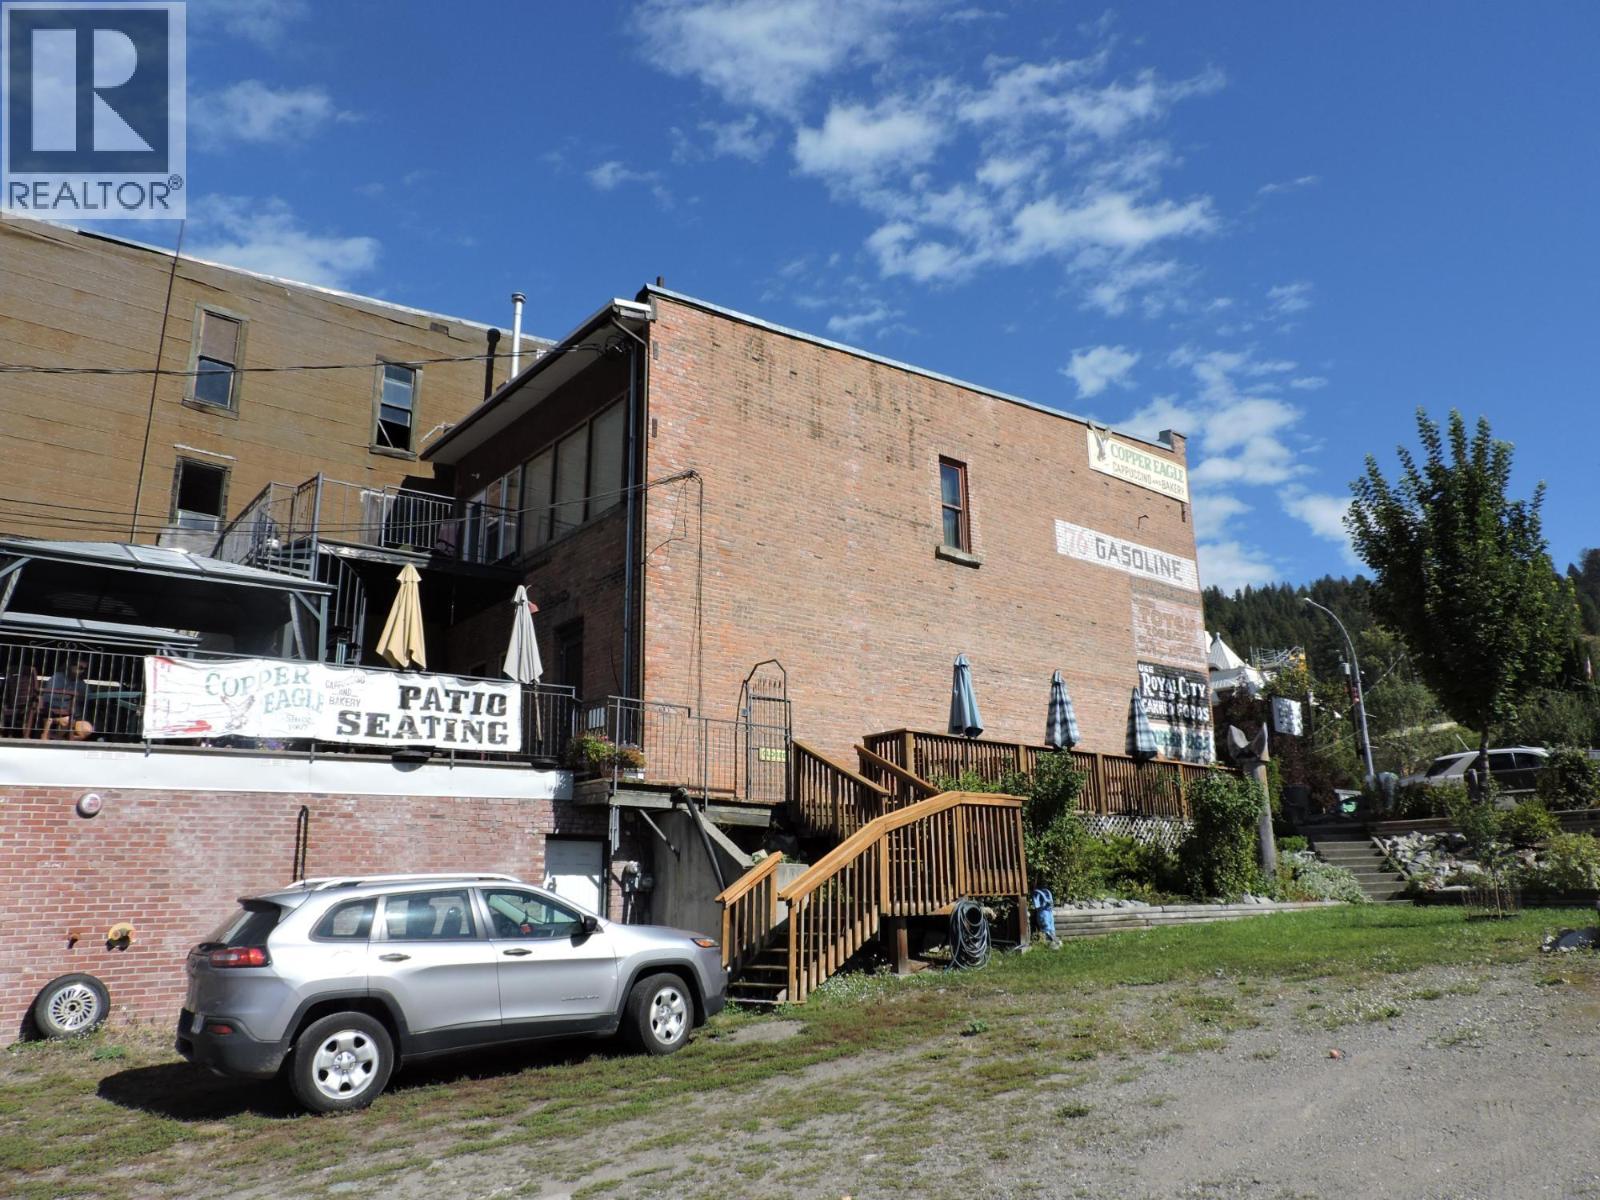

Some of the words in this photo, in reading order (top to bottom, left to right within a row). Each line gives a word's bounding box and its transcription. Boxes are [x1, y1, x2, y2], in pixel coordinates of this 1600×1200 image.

[1110, 443, 1152, 472] COPPER
[1153, 459, 1185, 484] EAGLE
[1112, 461, 1152, 485] CAPPUCCINO
[1161, 479, 1185, 495] BAKERY
[1095, 536, 1183, 581] GASOLINE
[205, 665, 312, 698] COPPER
[1138, 663, 1154, 674] USE
[1140, 672, 1178, 697] ROYAL
[329, 695, 361, 707] BAKERY
[398, 684, 508, 717] PATIO
[336, 709, 509, 746] SEATING
